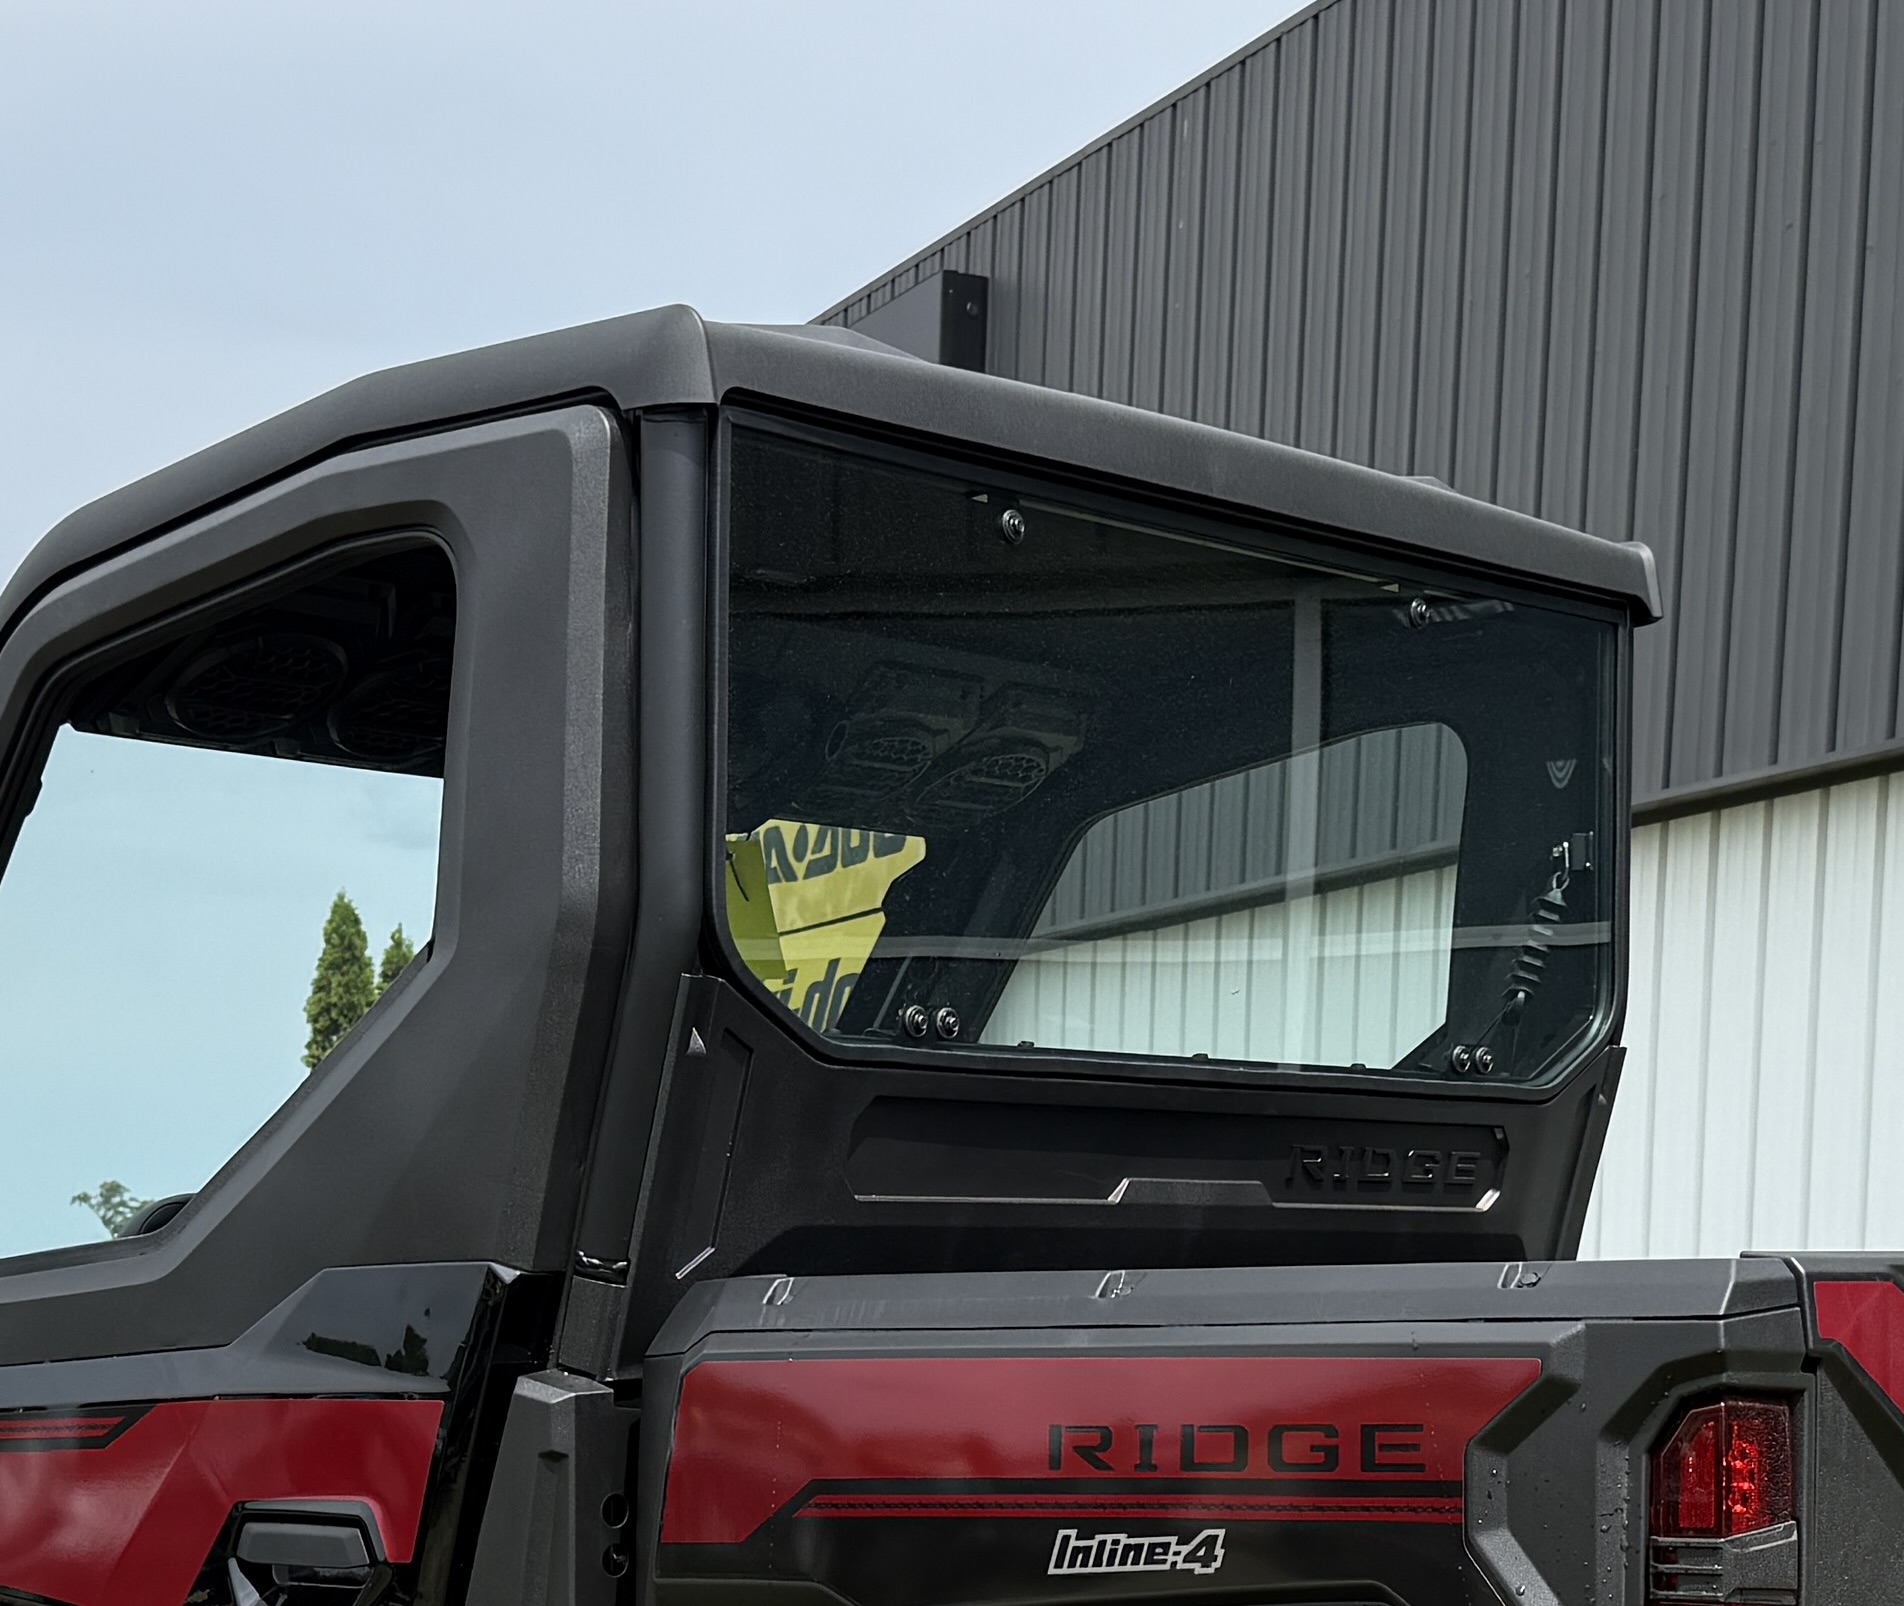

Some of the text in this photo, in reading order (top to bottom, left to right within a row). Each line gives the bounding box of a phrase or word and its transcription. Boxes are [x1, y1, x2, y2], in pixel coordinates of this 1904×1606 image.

[1288, 1144, 1482, 1184] RIDGE
[1048, 1424, 1426, 1473] RIDGE
[1047, 1528, 1226, 1575] Inline-4
